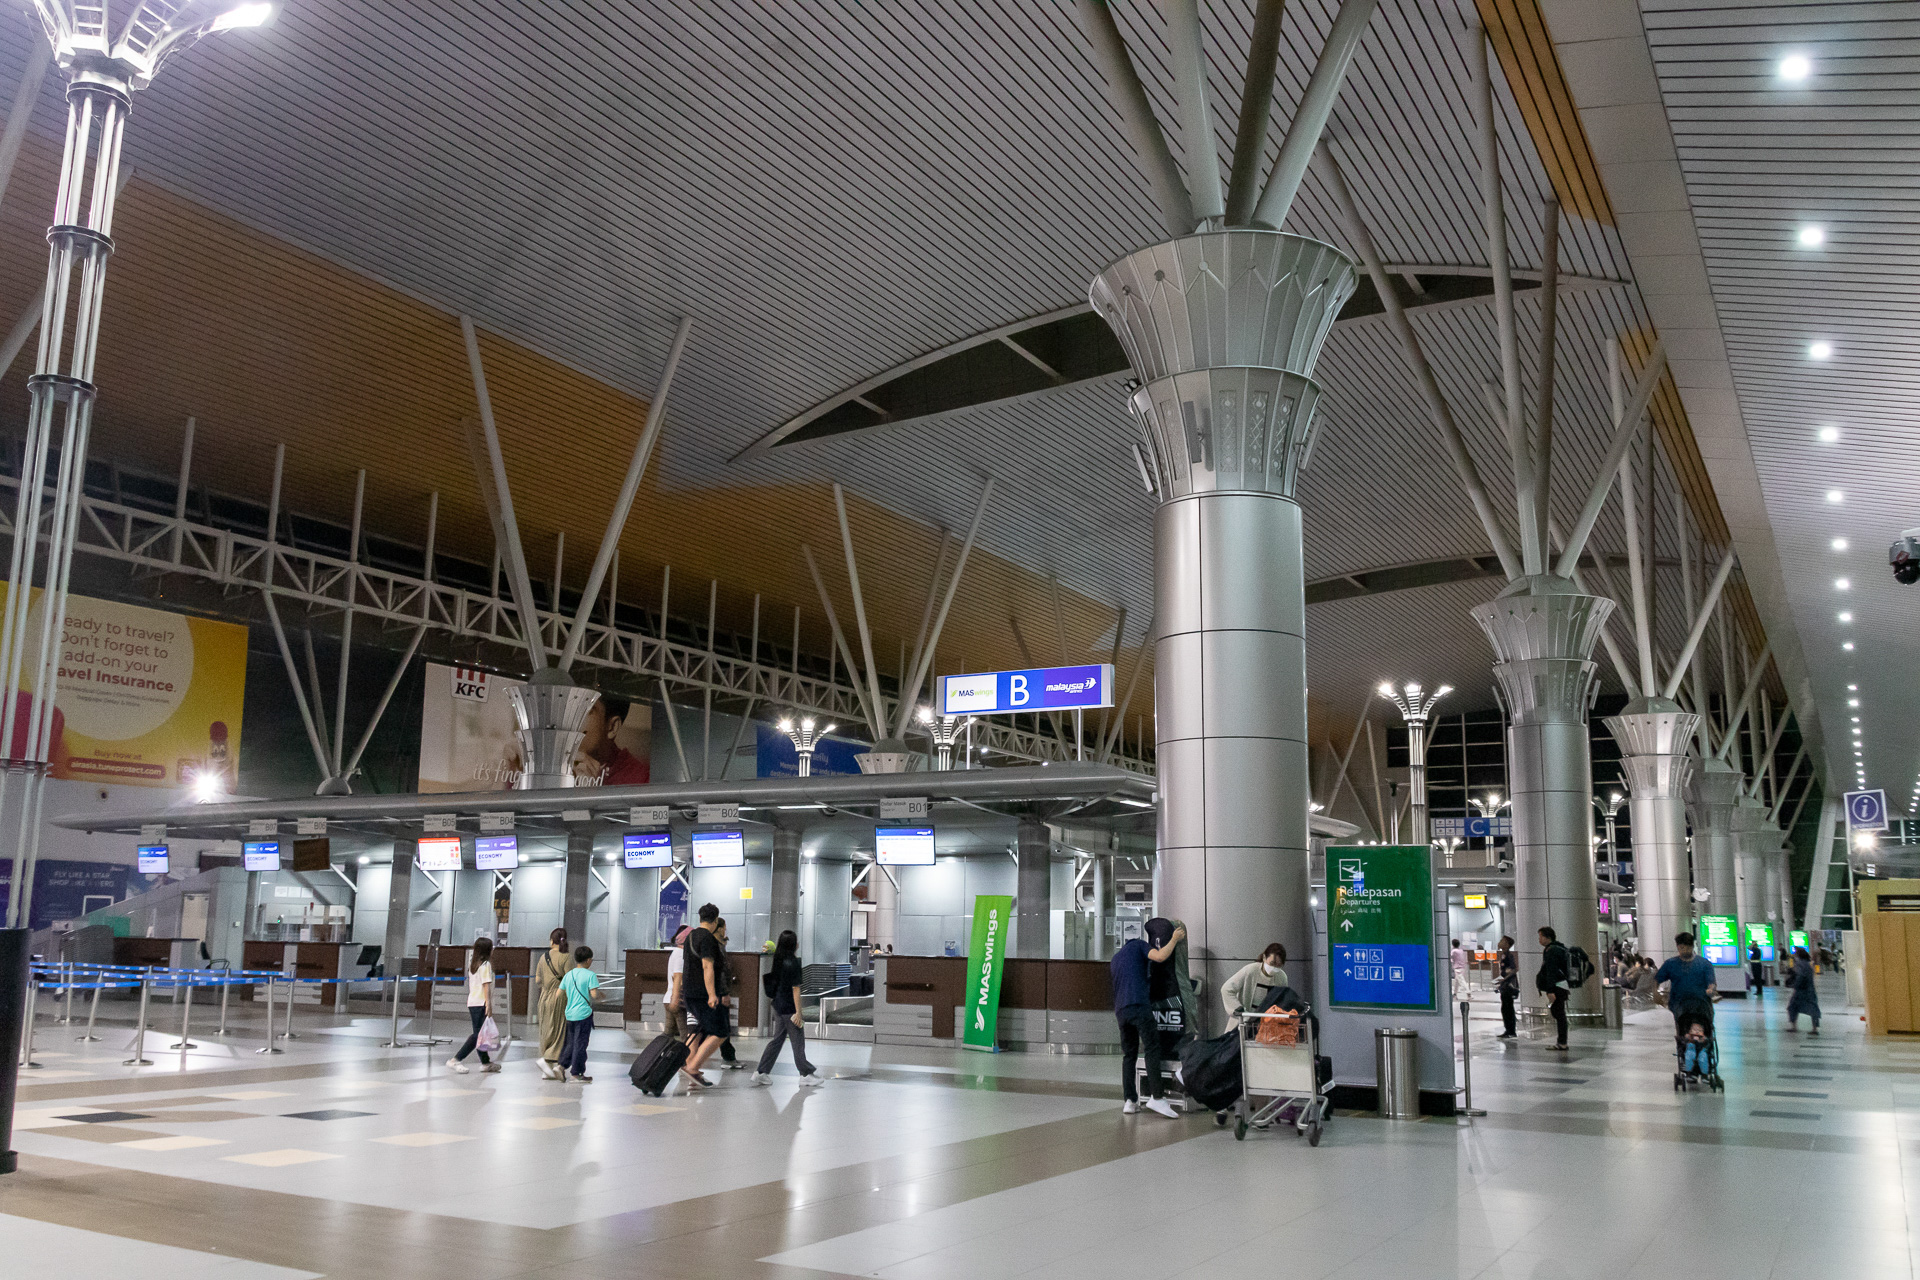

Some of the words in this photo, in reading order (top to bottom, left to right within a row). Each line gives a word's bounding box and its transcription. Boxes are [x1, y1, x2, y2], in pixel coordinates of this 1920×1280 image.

[53, 612, 102, 633] eady
[106, 621, 121, 636] to
[125, 625, 175, 644] travel?
[60, 630, 100, 649] Don't
[104, 637, 149, 656] forget
[154, 646, 168, 660] to
[64, 650, 121, 668] add-on
[124, 660, 158, 674] your
[96, 670, 177, 692] Insurance.
[455, 682, 486, 699] KFC
[958, 688, 994, 698] MASwings
[1010, 674, 1030, 706] B
[1046, 680, 1085, 694] malaysia
[112, 752, 132, 760] now
[473, 762, 491, 782] it's
[494, 759, 522, 790] fing
[652, 810, 668, 820] B03
[721, 808, 738, 818] B02
[908, 802, 927, 813] B01
[442, 818, 456, 827] B05
[500, 816, 513, 825] B04
[1470, 819, 1485, 835] C
[1340, 885, 1402, 900] Perlepasan
[1340, 898, 1381, 907] Departures
[978, 908, 998, 1005] MASwings
